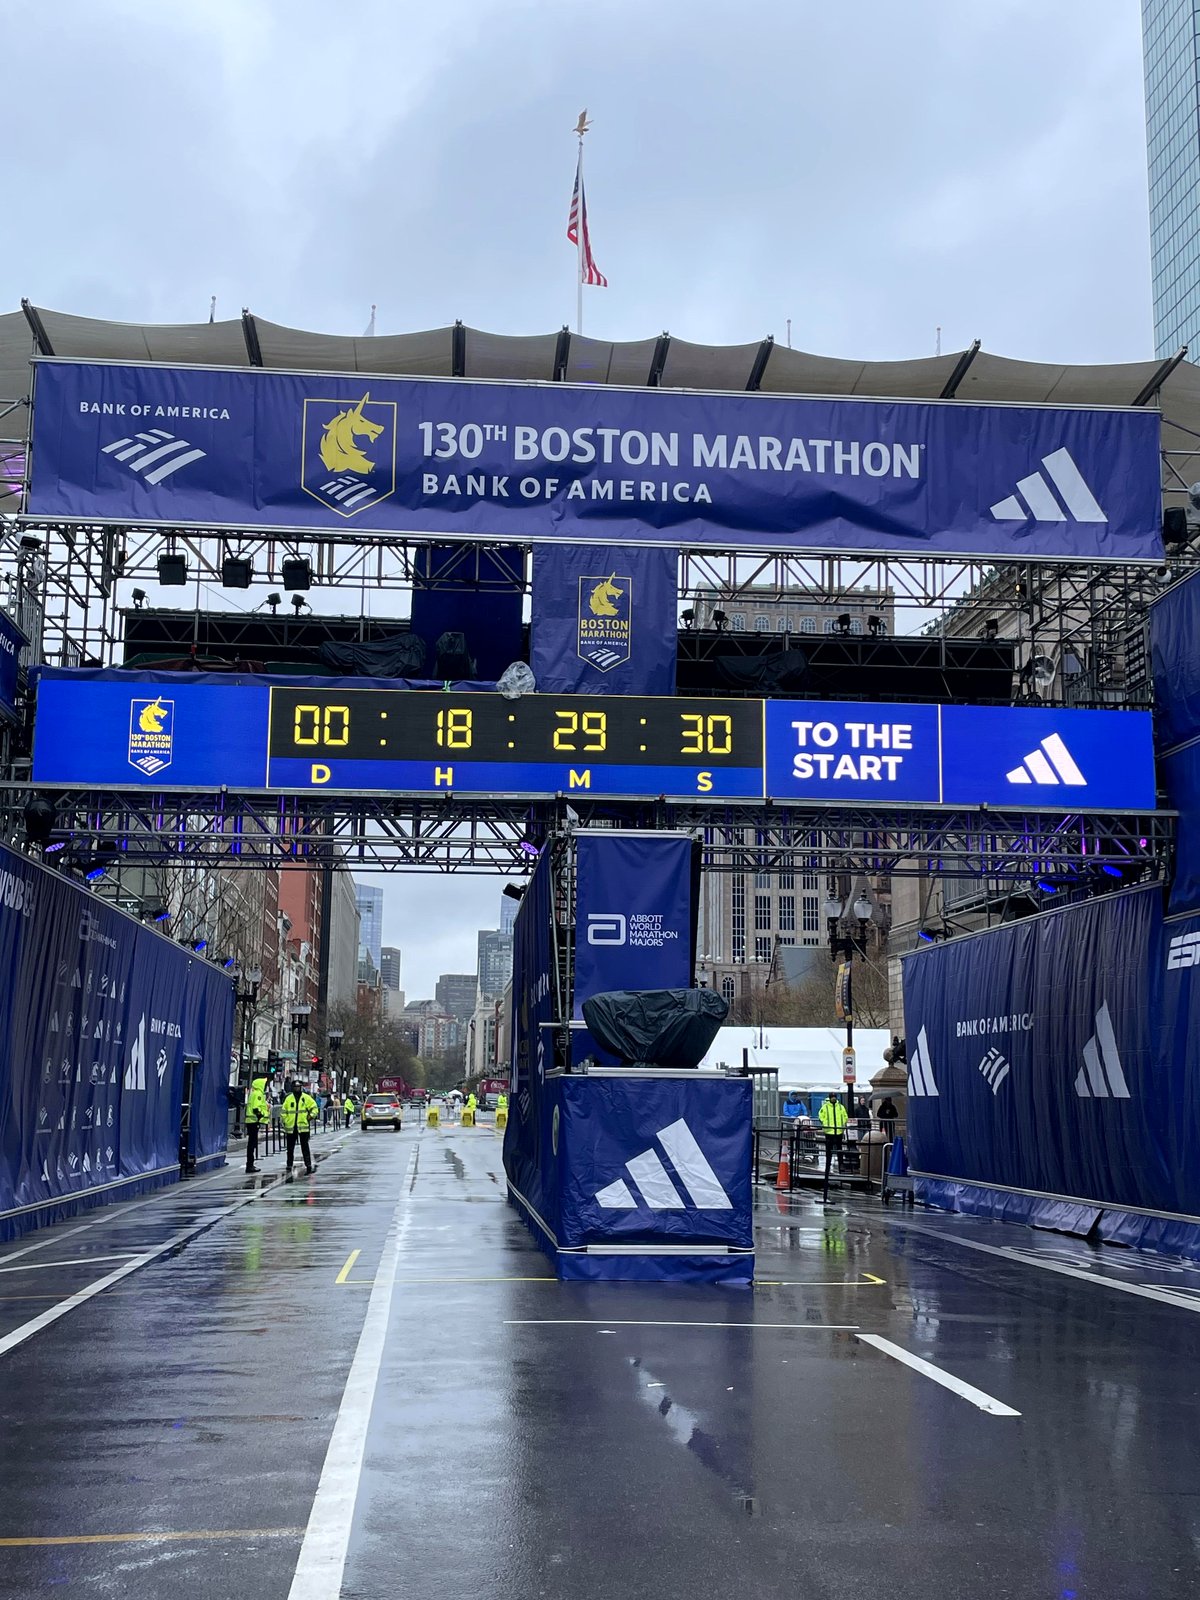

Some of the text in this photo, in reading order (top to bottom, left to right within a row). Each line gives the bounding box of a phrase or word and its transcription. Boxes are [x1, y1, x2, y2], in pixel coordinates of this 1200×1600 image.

[79, 401, 231, 420] BANK OF AMERICA
[418, 421, 508, 459] 130TH
[514, 426, 679, 467] BOSTON
[422, 473, 713, 504] BANK OF AMERICA
[581, 619, 628, 630] BOSTON
[581, 630, 628, 639] MARATHON
[294, 704, 350, 746] 00
[436, 708, 473, 749] 18
[553, 711, 607, 751] 29
[680, 714, 732, 754] 30
[791, 721, 913, 750] TO THE
[311, 764, 713, 792] D H M S
[792, 752, 904, 781] START
[629, 914, 663, 923] ABBOTT
[629, 931, 678, 939] MARATHON
[956, 1020, 978, 1038] BANK
[979, 1017, 991, 1035] OF
